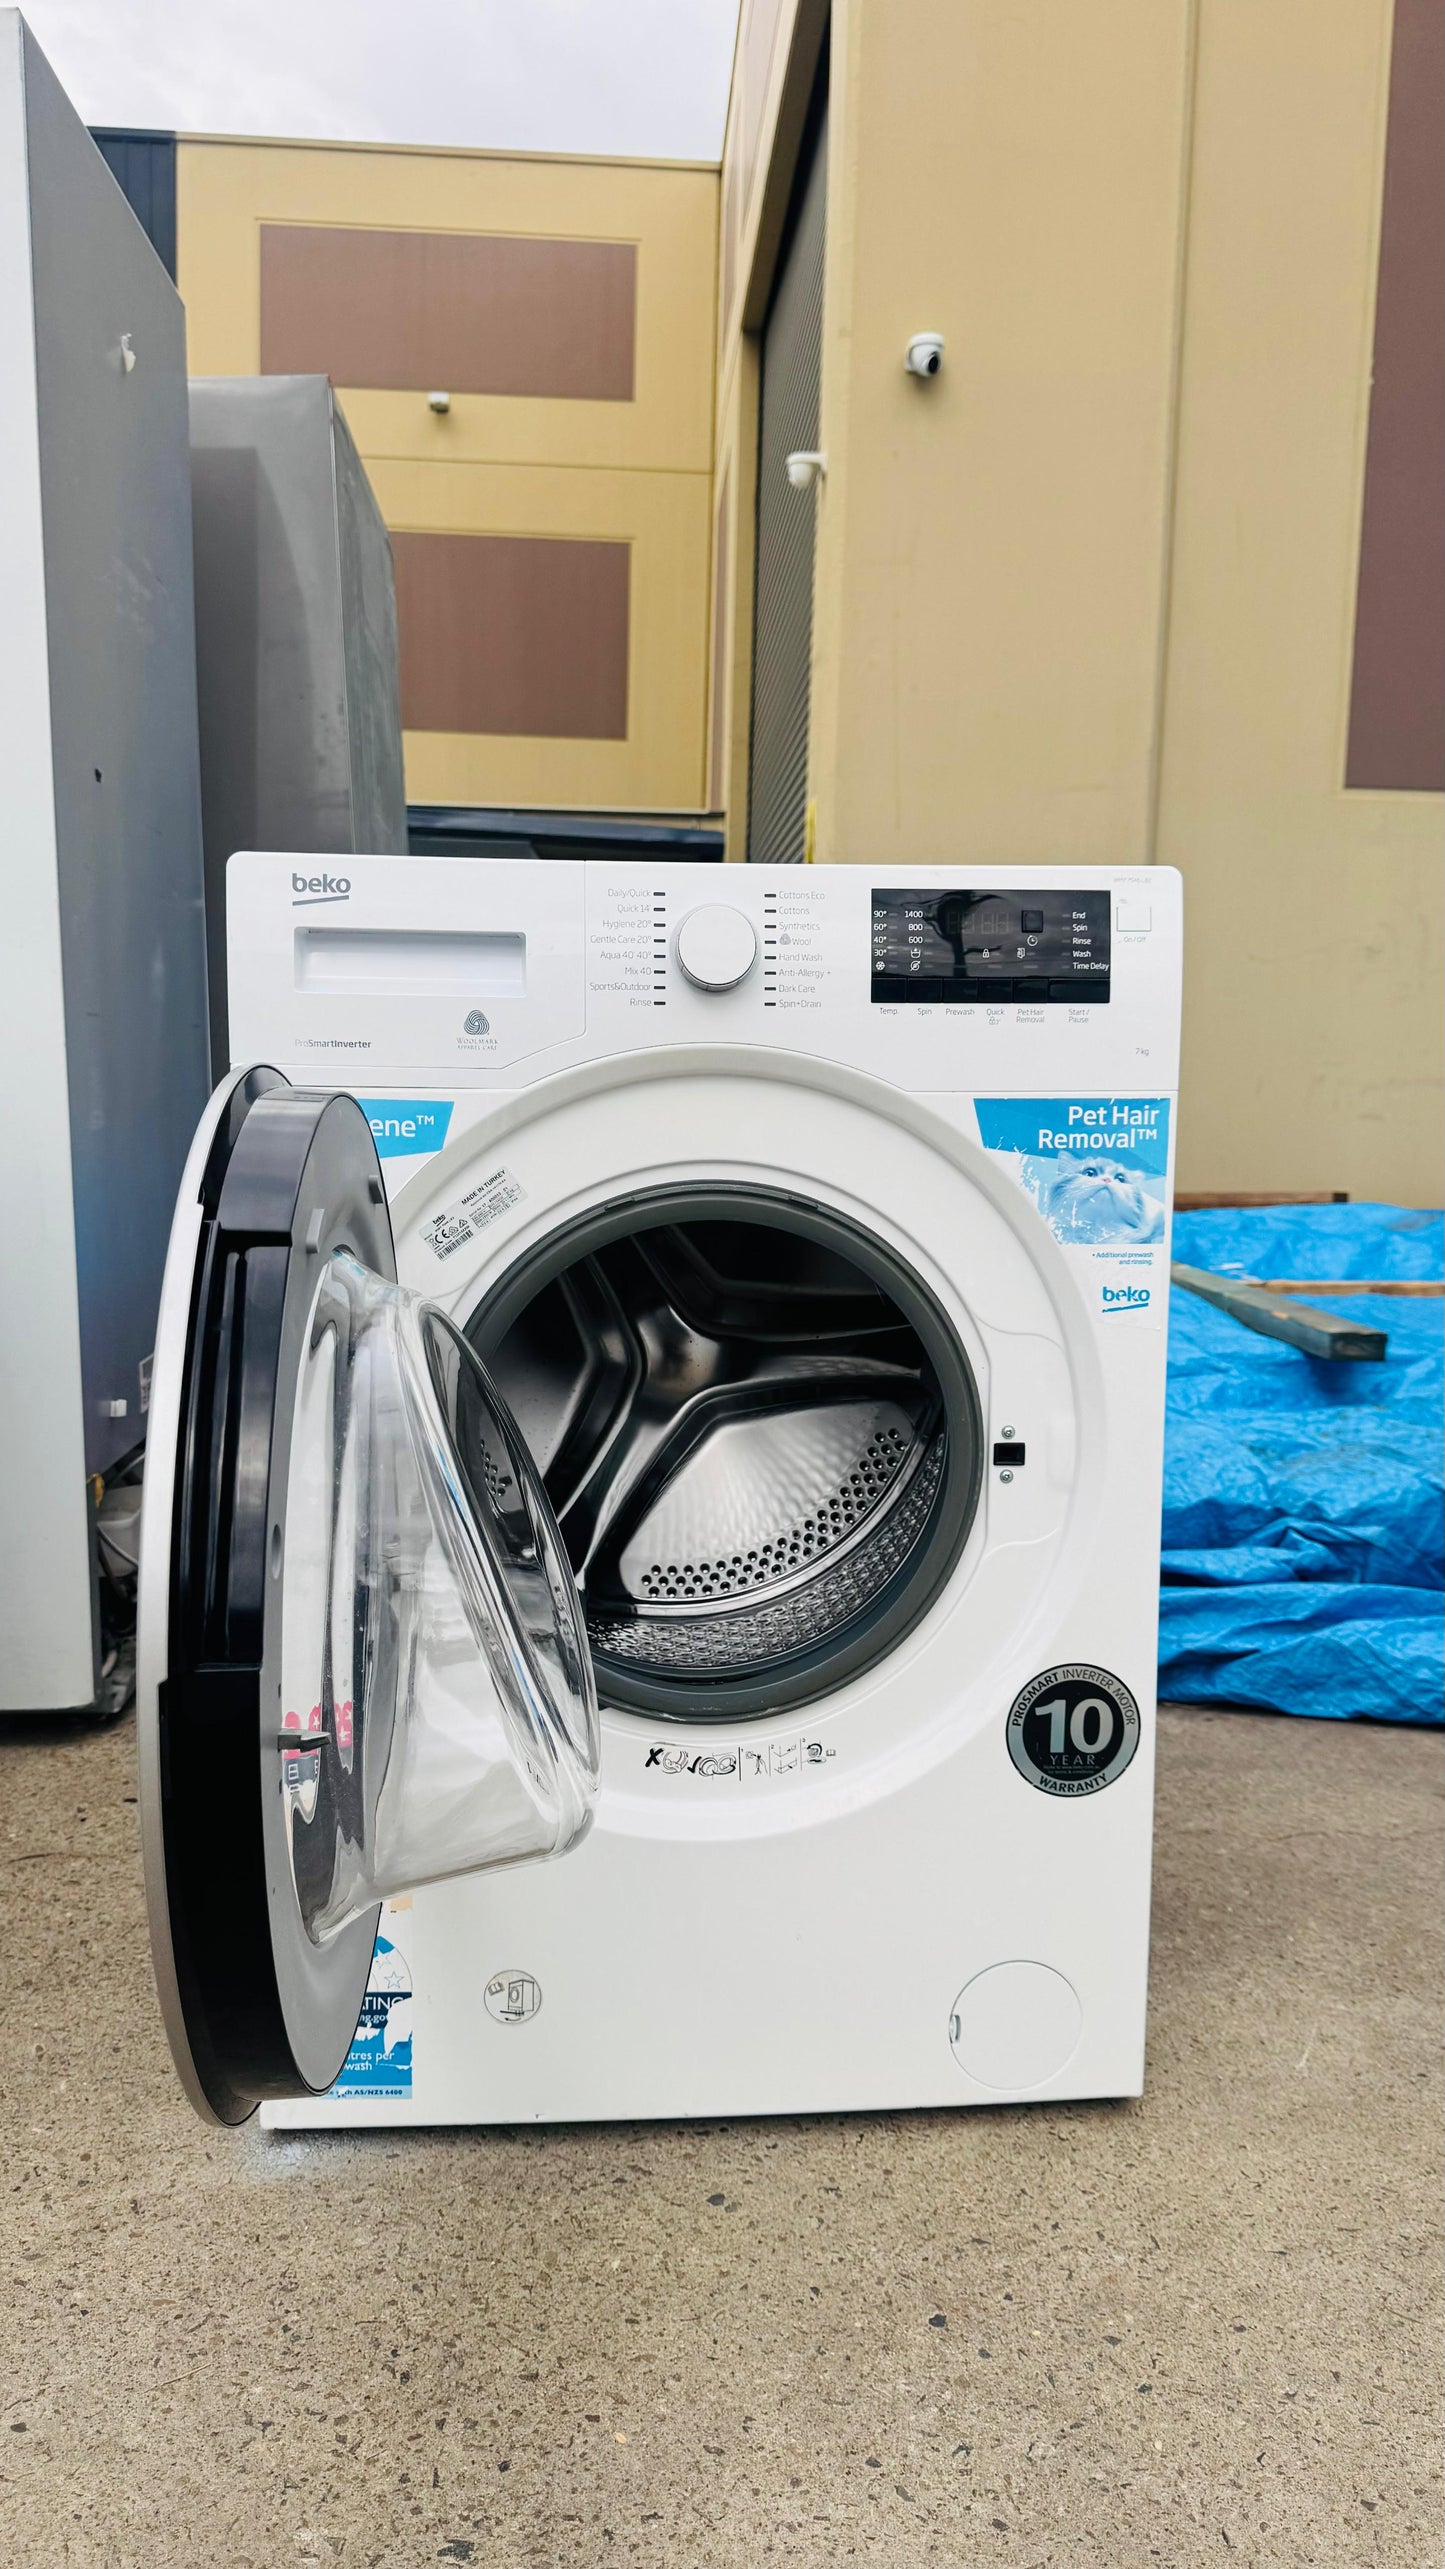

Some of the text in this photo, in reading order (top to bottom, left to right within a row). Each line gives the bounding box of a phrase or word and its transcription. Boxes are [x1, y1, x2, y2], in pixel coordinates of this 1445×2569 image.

[291, 873, 351, 893] beko
[607, 888, 651, 898] Daily/Quick
[779, 891, 810, 899] Cottons
[617, 904, 638, 913] Quick
[779, 906, 810, 914] Cottons
[905, 910, 923, 918] 1400
[602, 919, 636, 929] Hygiene
[779, 921, 821, 931] Synthetics
[873, 923, 887, 931] 60°
[908, 923, 923, 931] 800
[1072, 924, 1088, 932] Spin
[590, 935, 616, 943] Gentle
[617, 935, 636, 943] Care
[791, 937, 812, 945] Wool
[908, 936, 923, 944] 600
[1072, 937, 1092, 945] Rinse
[600, 951, 621, 960] Aqua
[779, 953, 823, 961] Hand Wash
[1072, 950, 1092, 958] Wash
[624, 967, 639, 975] Mix
[1072, 962, 1110, 971] Time Delay
[779, 968, 825, 979] Anti-Allergy
[589, 983, 652, 992] Sports&Outdoor
[779, 984, 816, 993] Dark Care
[629, 998, 652, 1007] Rinse
[917, 1008, 933, 1016] Spin
[945, 1008, 975, 1016] Prewash
[986, 1008, 1005, 1016] Quick
[294, 1039, 372, 1048] ProSmartInverter
[456, 1037, 498, 1045] WOOLMARK
[1068, 1105, 1160, 1126] Pet Hair
[1037, 1127, 1158, 1149] Removal™
[461, 1169, 506, 1205] MADE IN TURKEY
[1102, 1286, 1151, 1302] beko
[1011, 1668, 1136, 1727] PROSMART INVERTER MOTOR
[1034, 1697, 1114, 1754] 10
[1050, 1754, 1096, 1766] YEAR
[1039, 1772, 1108, 1793] WARRANTY
